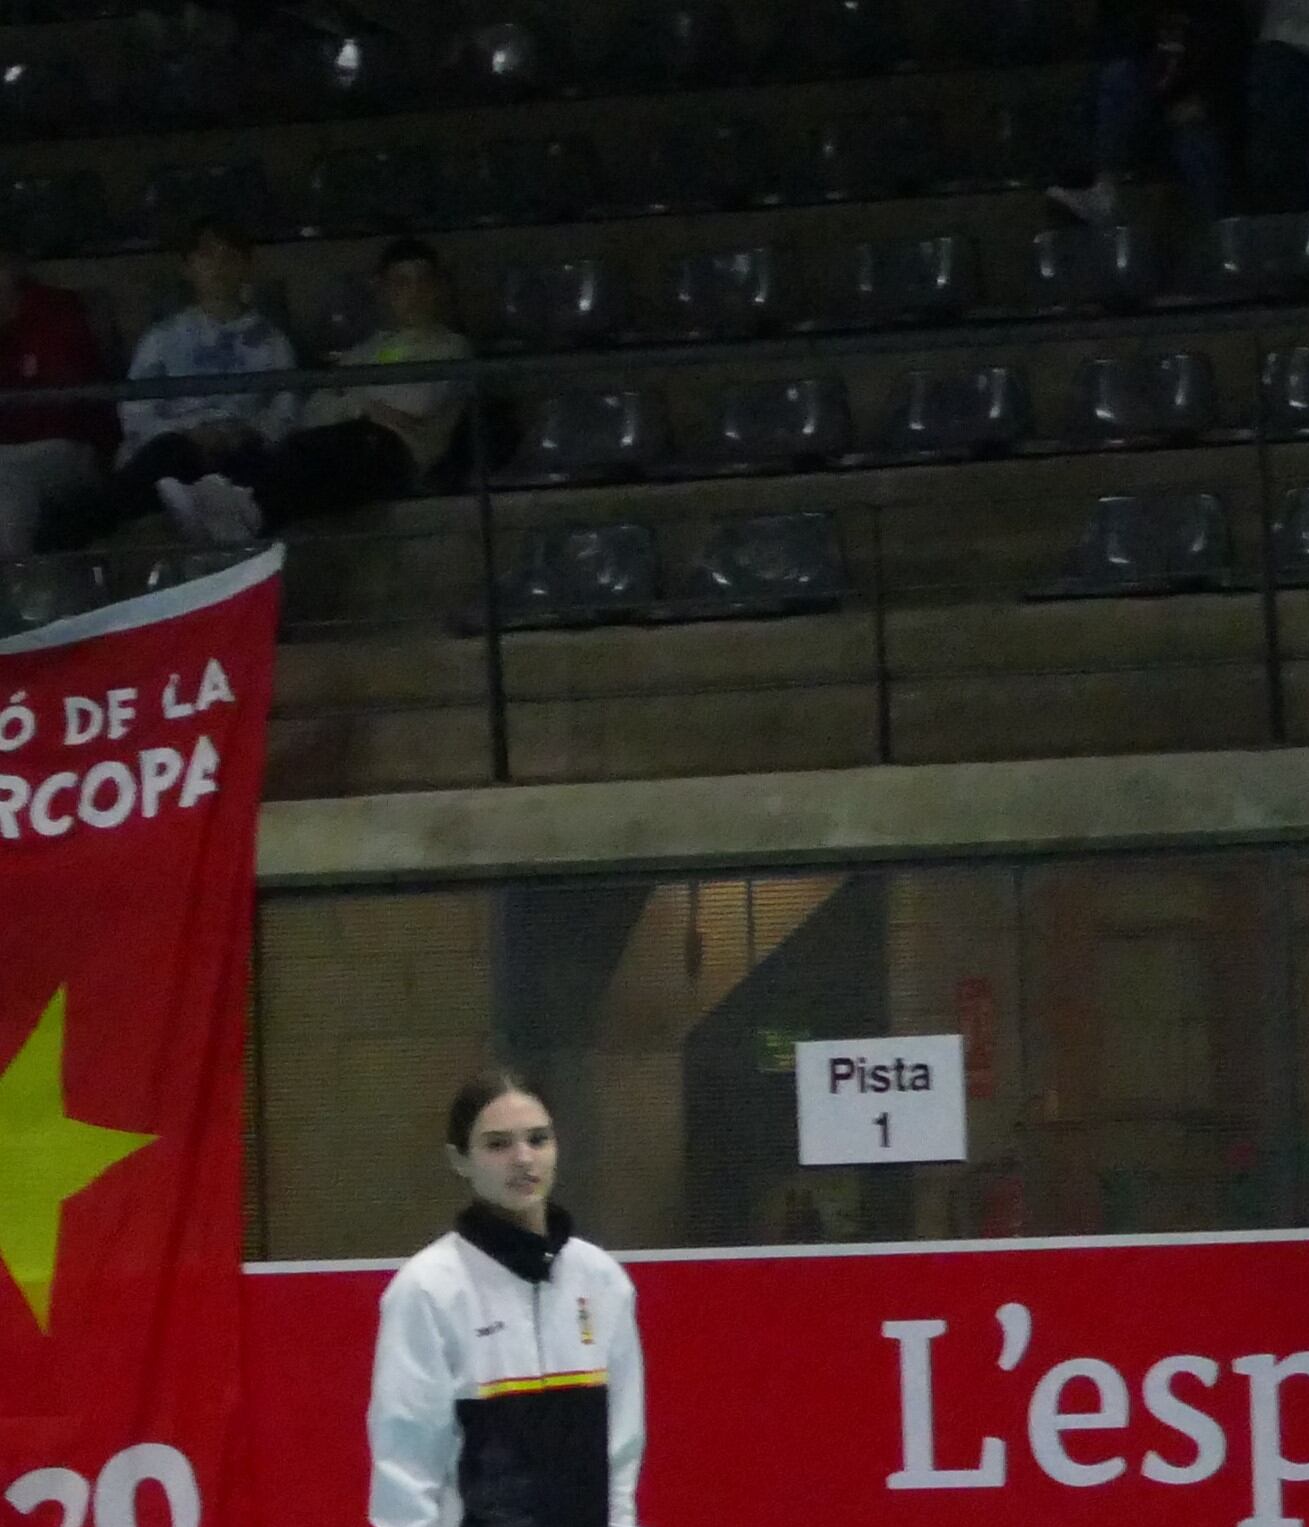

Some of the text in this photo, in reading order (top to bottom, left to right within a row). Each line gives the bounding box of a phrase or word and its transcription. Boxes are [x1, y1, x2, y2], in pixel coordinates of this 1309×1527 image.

[63, 688, 138, 745] DE
[162, 657, 235, 718] LA
[828, 1057, 931, 1094] Pista
[873, 1113, 892, 1148] 1
